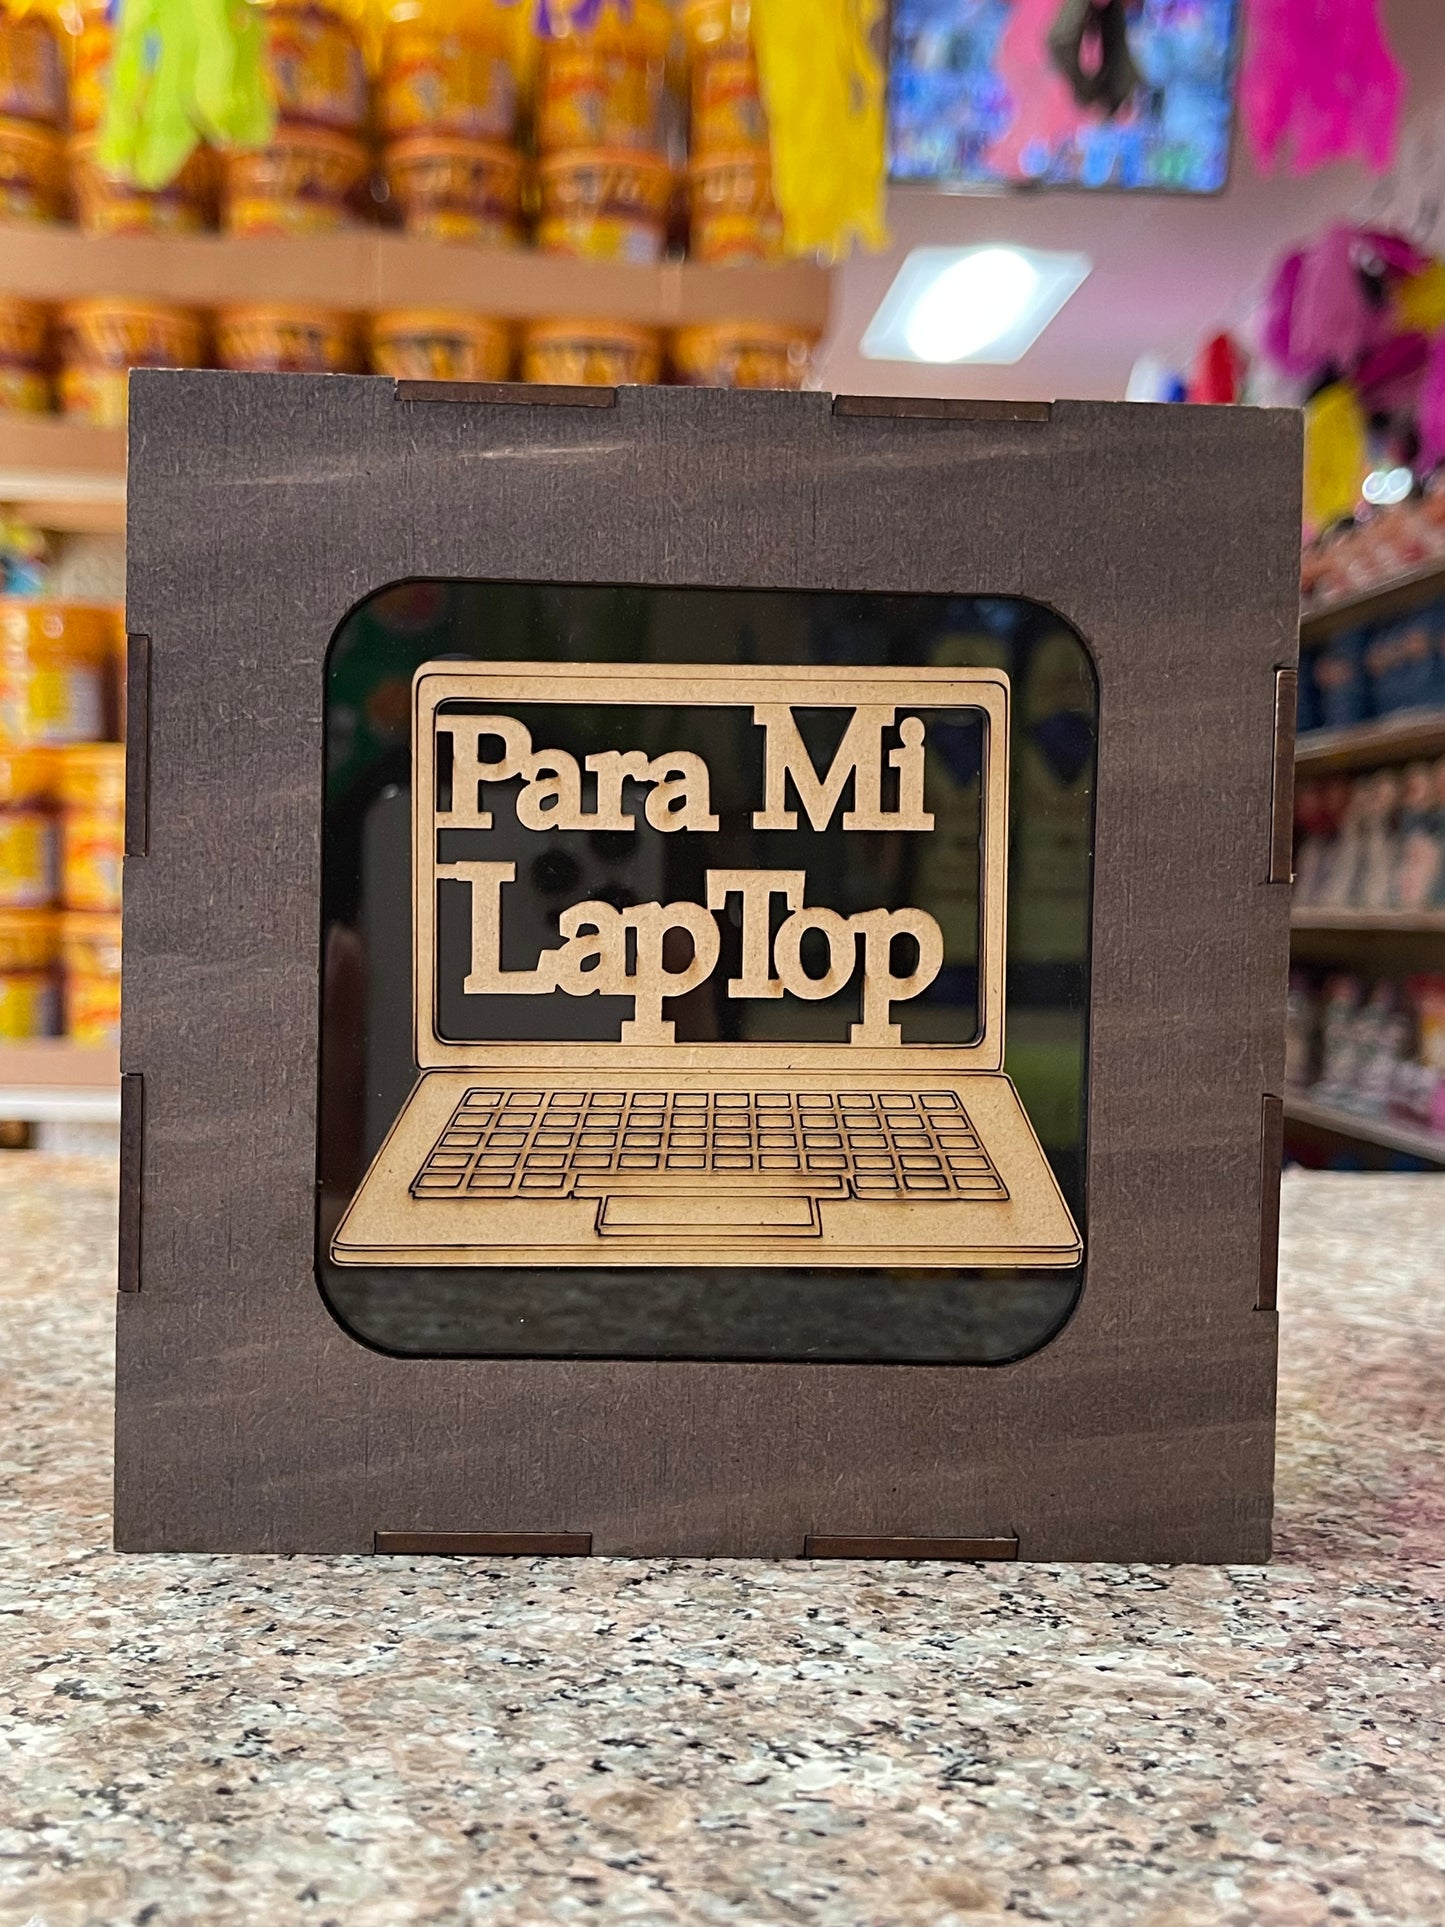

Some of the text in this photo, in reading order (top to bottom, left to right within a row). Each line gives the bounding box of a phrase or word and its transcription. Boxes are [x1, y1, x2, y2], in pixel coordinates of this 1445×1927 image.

[436, 705, 935, 832] Para Mi
[450, 860, 944, 1044] LapTop
